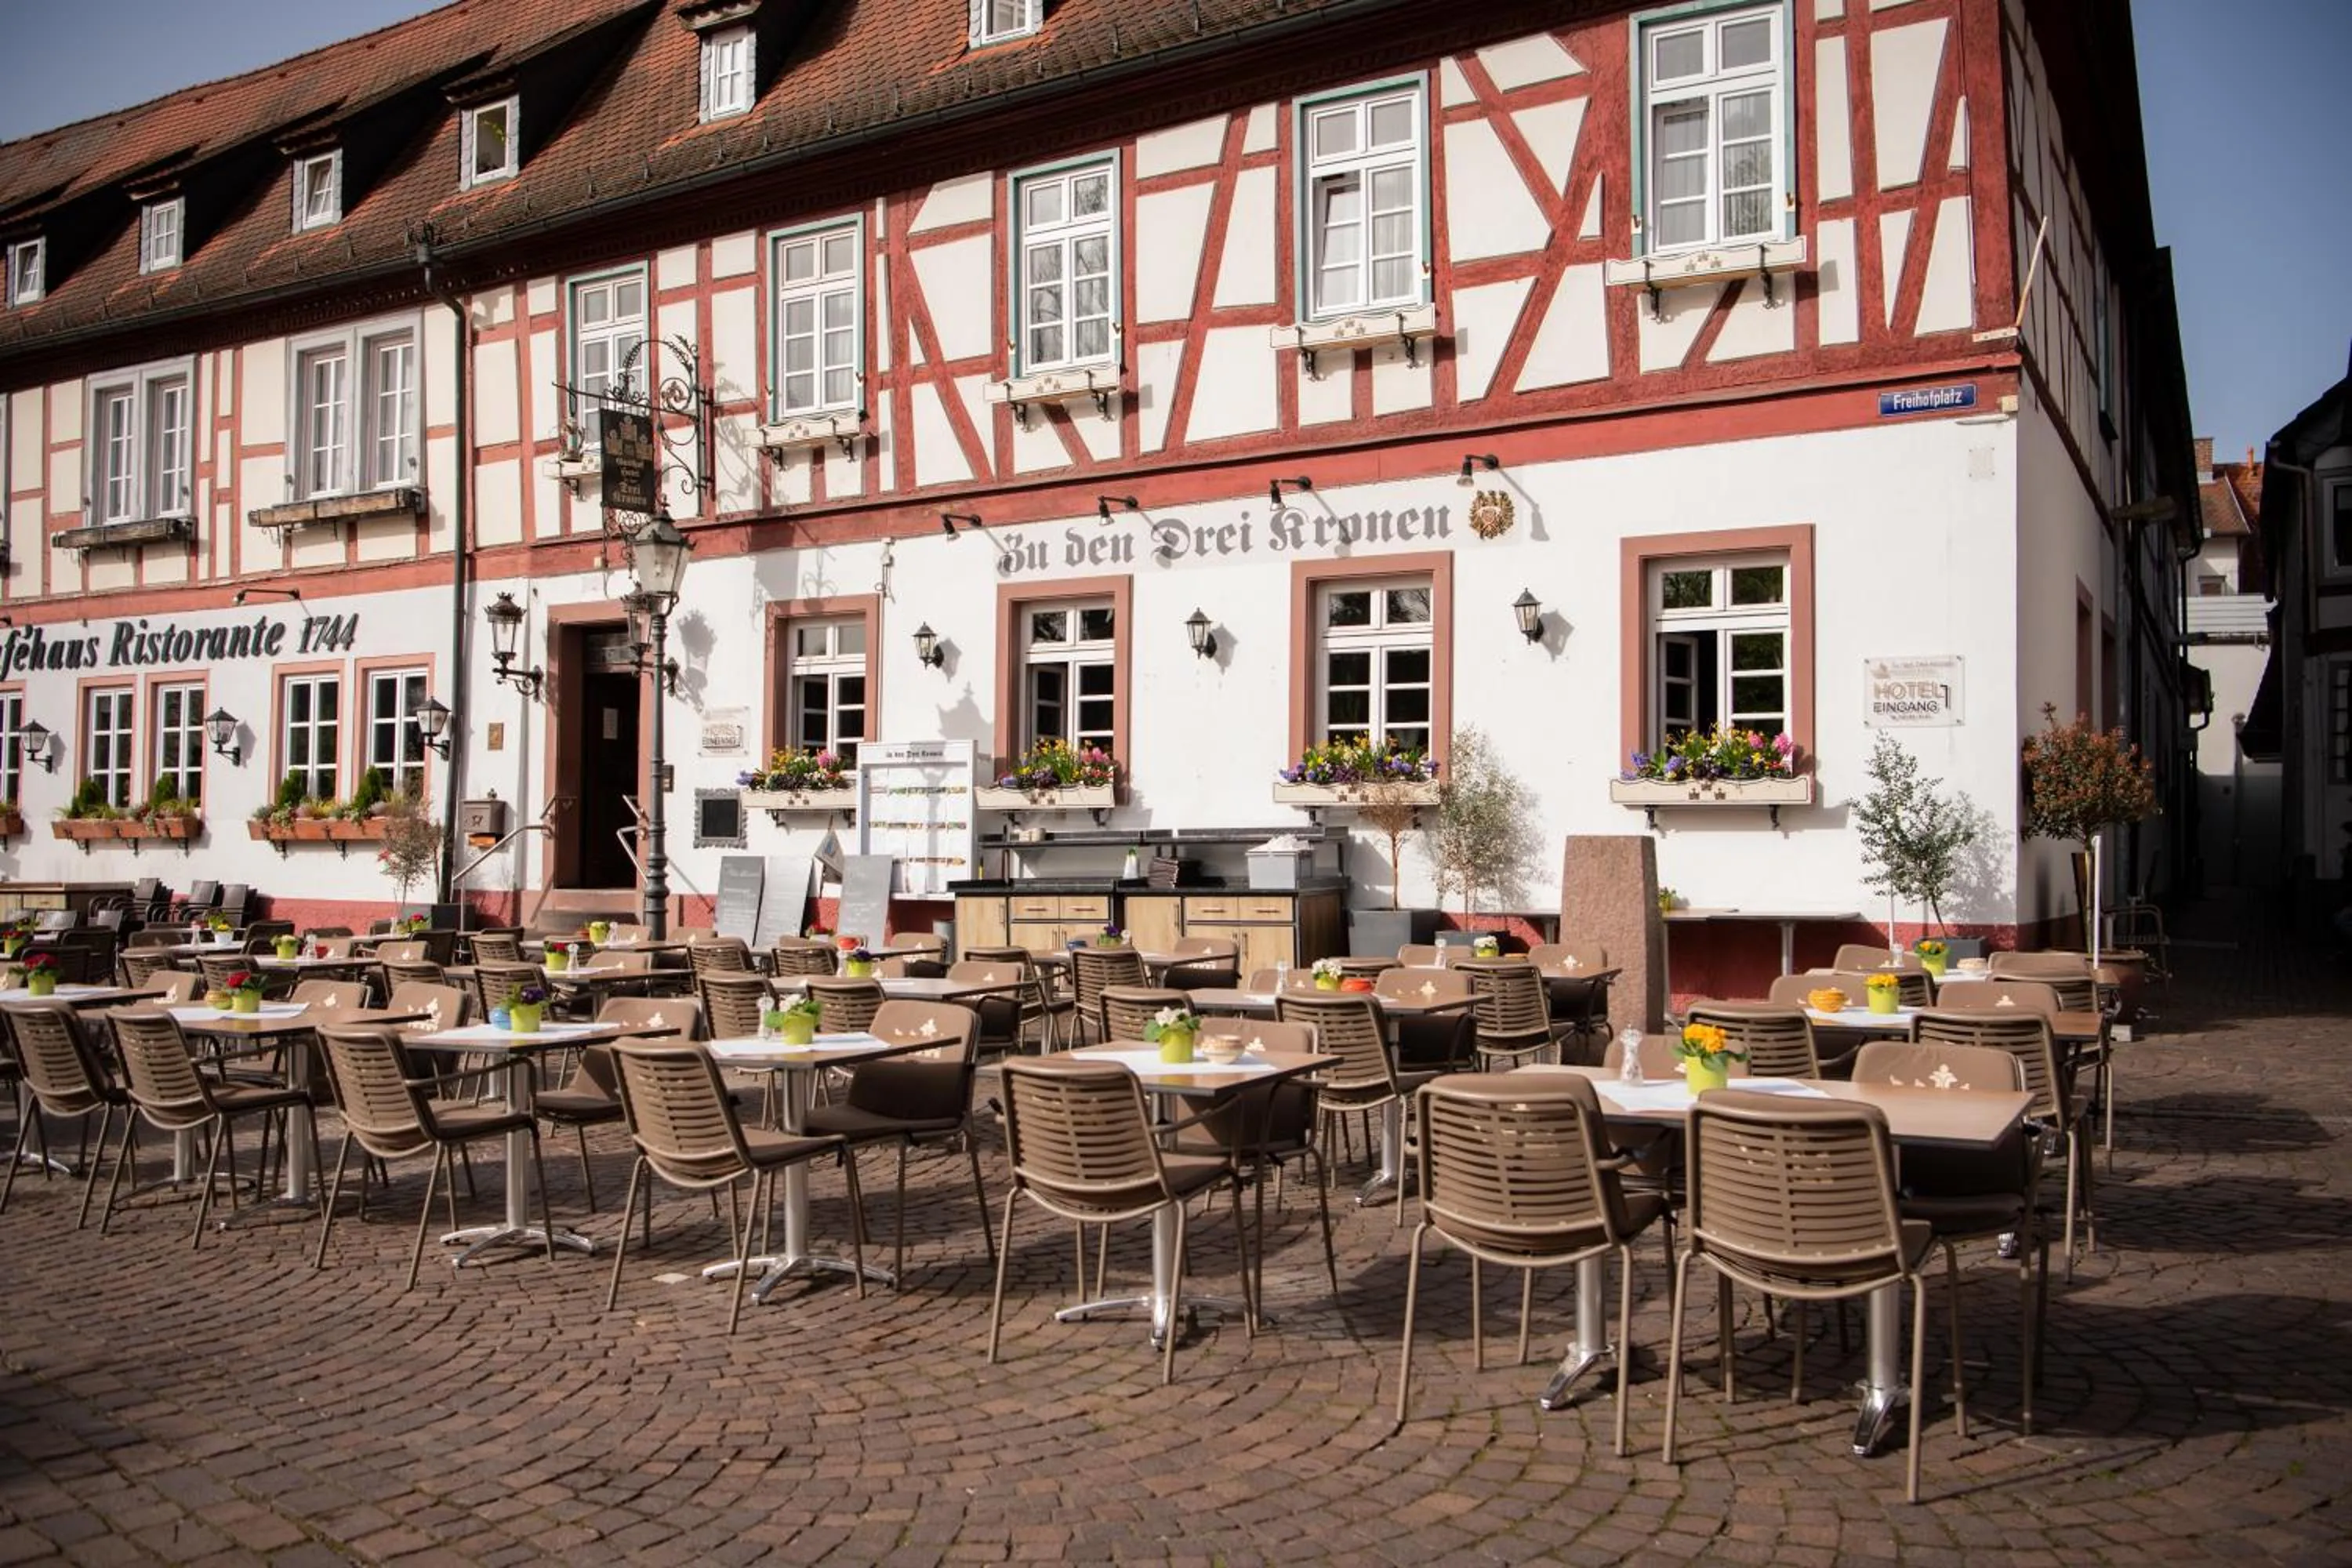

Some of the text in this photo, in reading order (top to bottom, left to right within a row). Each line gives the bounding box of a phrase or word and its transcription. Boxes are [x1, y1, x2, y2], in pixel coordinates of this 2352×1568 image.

[1893, 388, 1962, 409] Freihofplatz
[1000, 504, 1454, 573] Zu den Drei Kronen
[0, 612, 359, 682] féhaus Ristorante 1744
[1873, 681, 1945, 700] HOTEL
[1873, 700, 1939, 713] EINGANG
